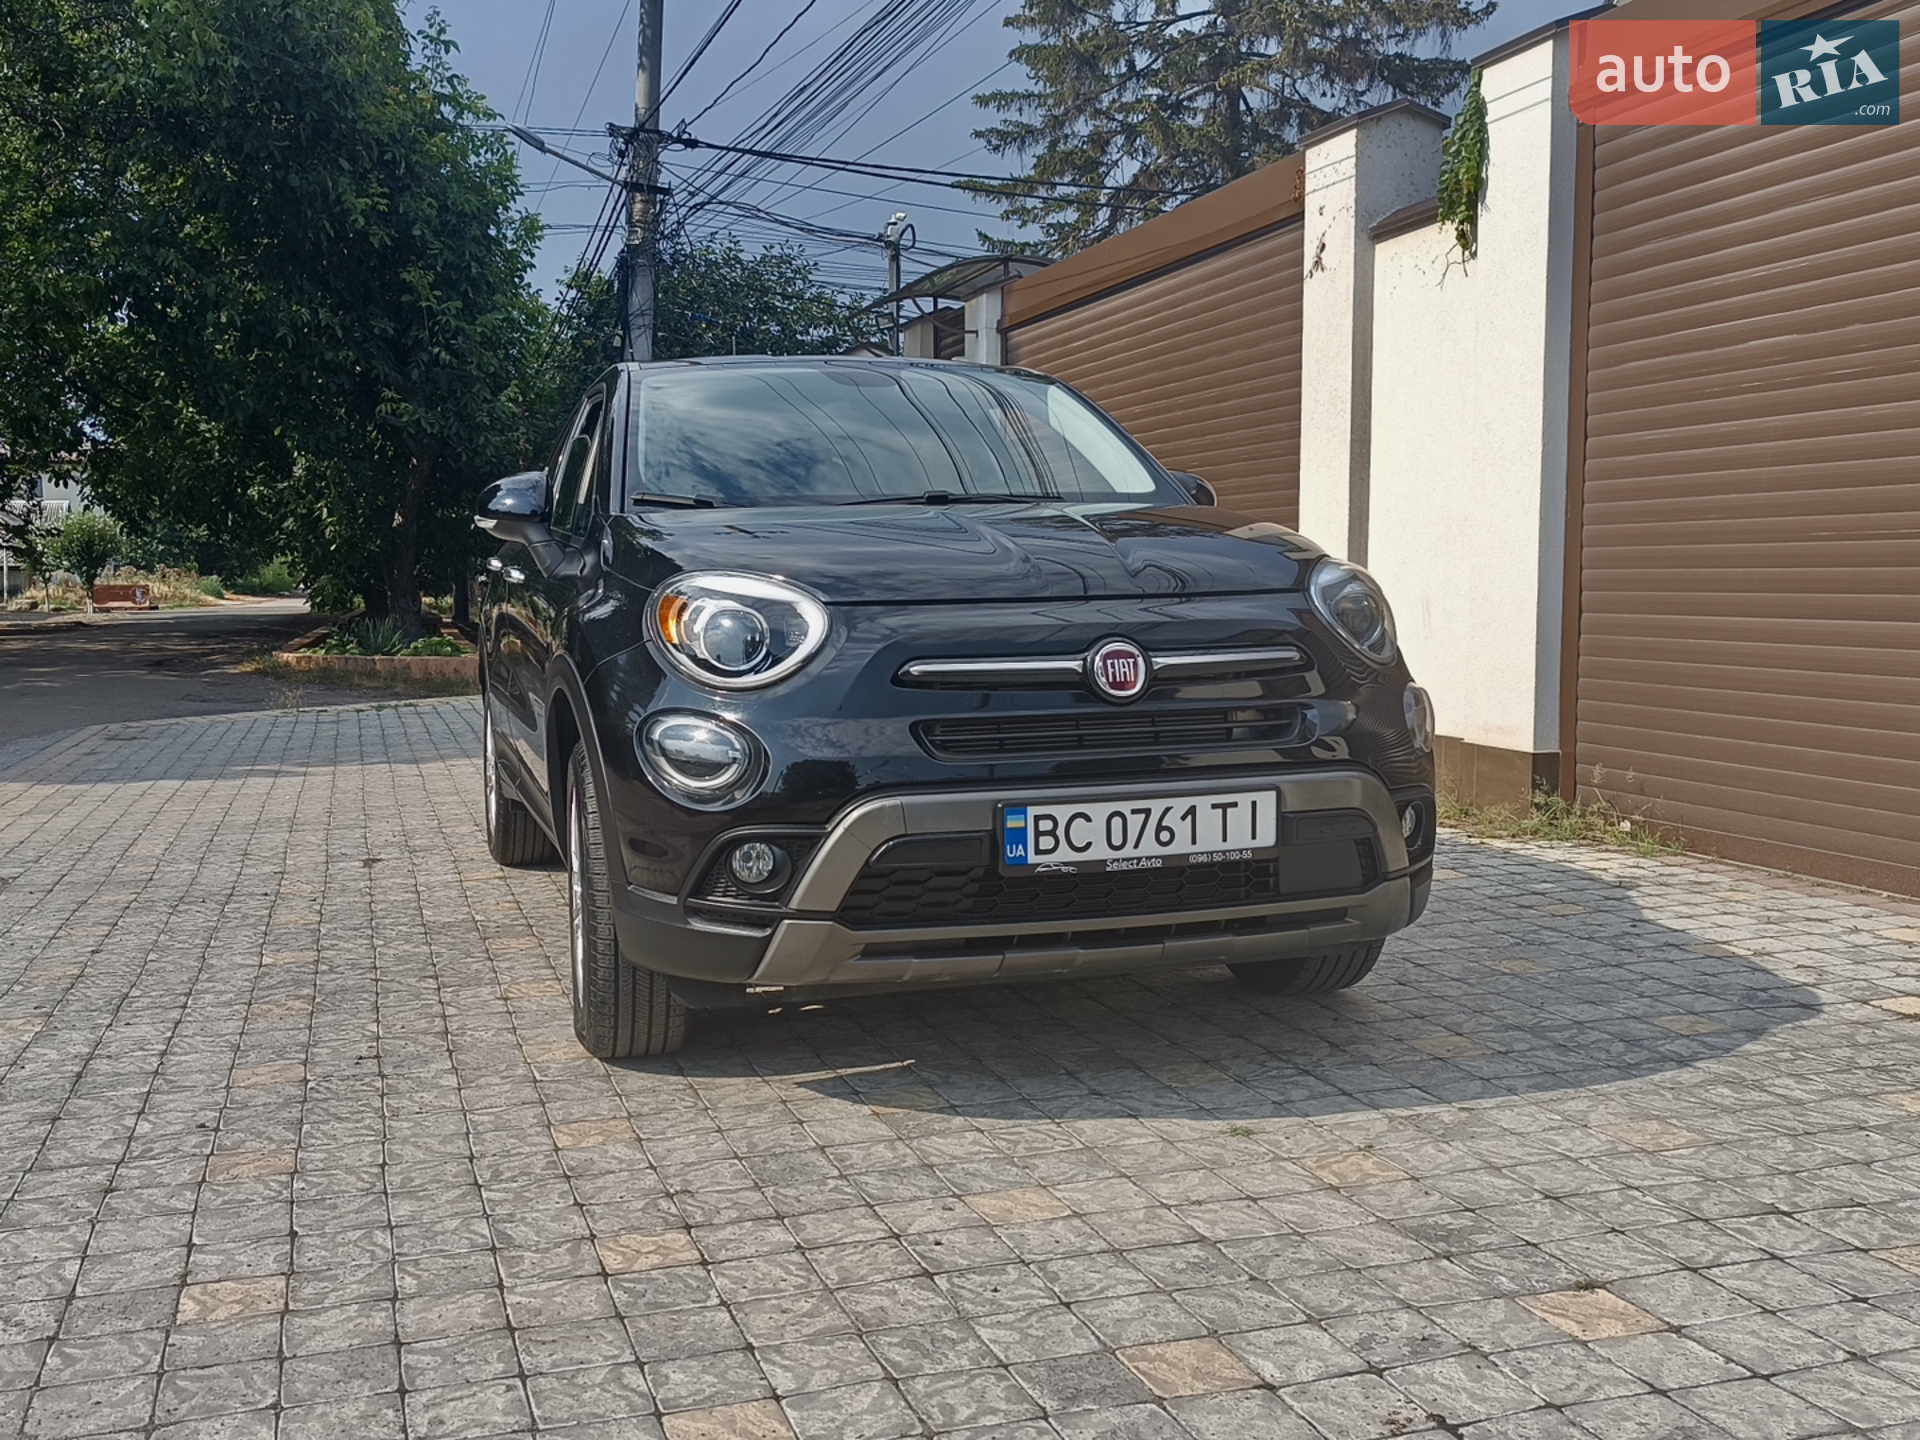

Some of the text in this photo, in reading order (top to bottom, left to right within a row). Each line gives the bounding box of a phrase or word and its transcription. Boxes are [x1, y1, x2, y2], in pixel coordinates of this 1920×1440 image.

[1106, 658, 1135, 682] FIAT
[1033, 800, 1257, 855] BC 0761 TI
[1006, 844, 1025, 857] UA
[1106, 857, 1163, 870] Select Avto
